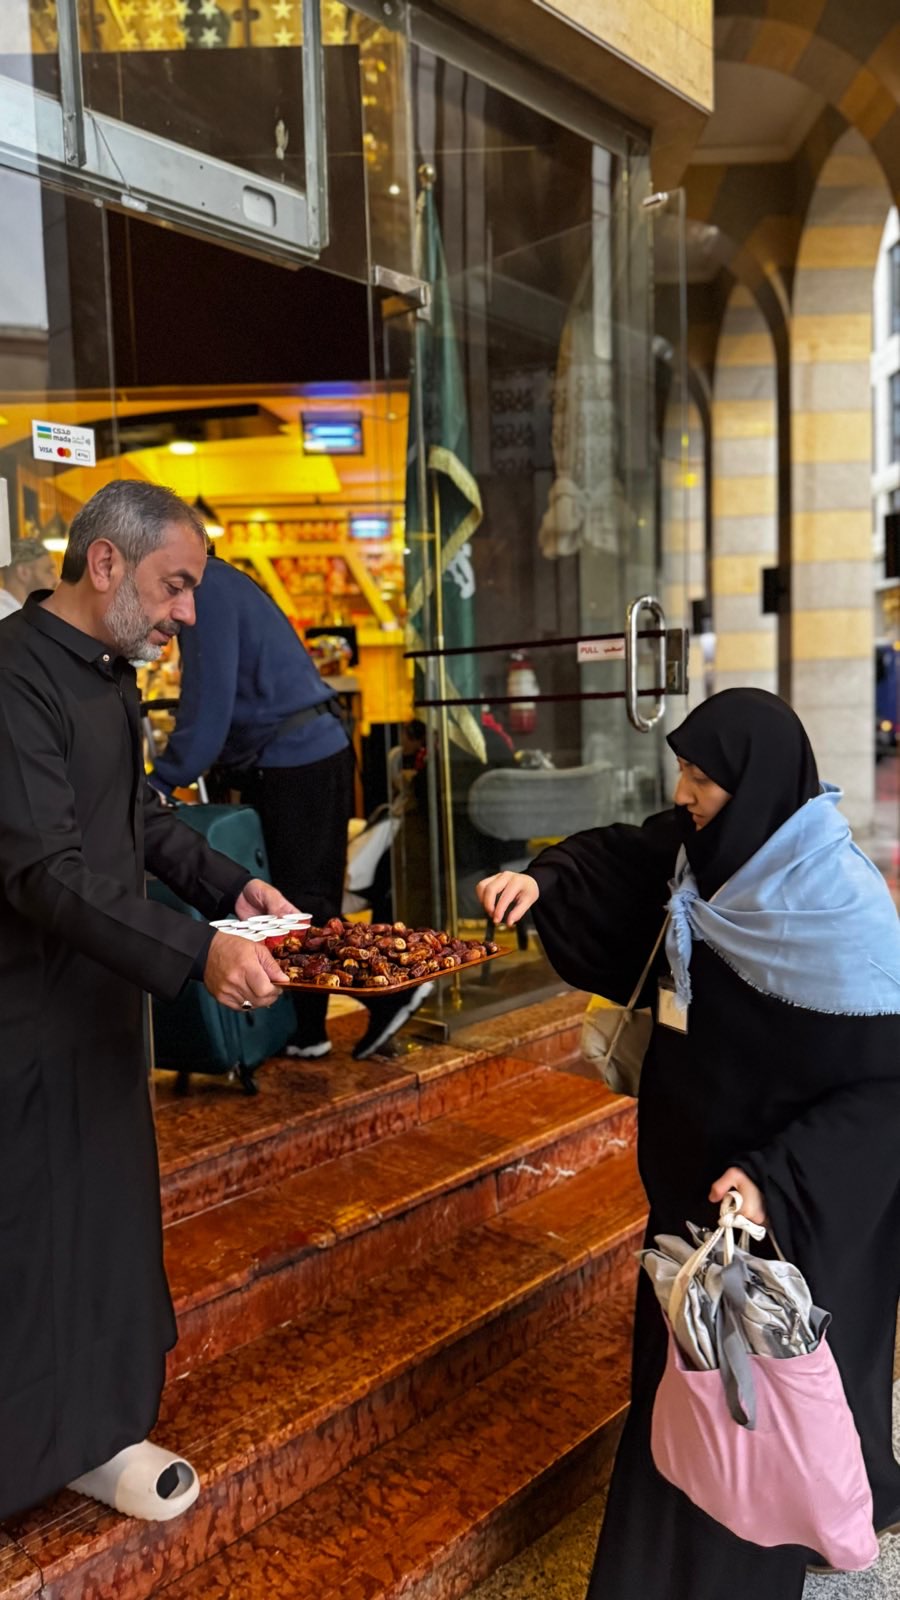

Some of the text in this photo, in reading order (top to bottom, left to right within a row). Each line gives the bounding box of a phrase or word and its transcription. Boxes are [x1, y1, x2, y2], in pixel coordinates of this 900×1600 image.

[53, 435, 71, 443] mada
[39, 446, 53, 454] VISA
[580, 646, 599, 654] PULL
